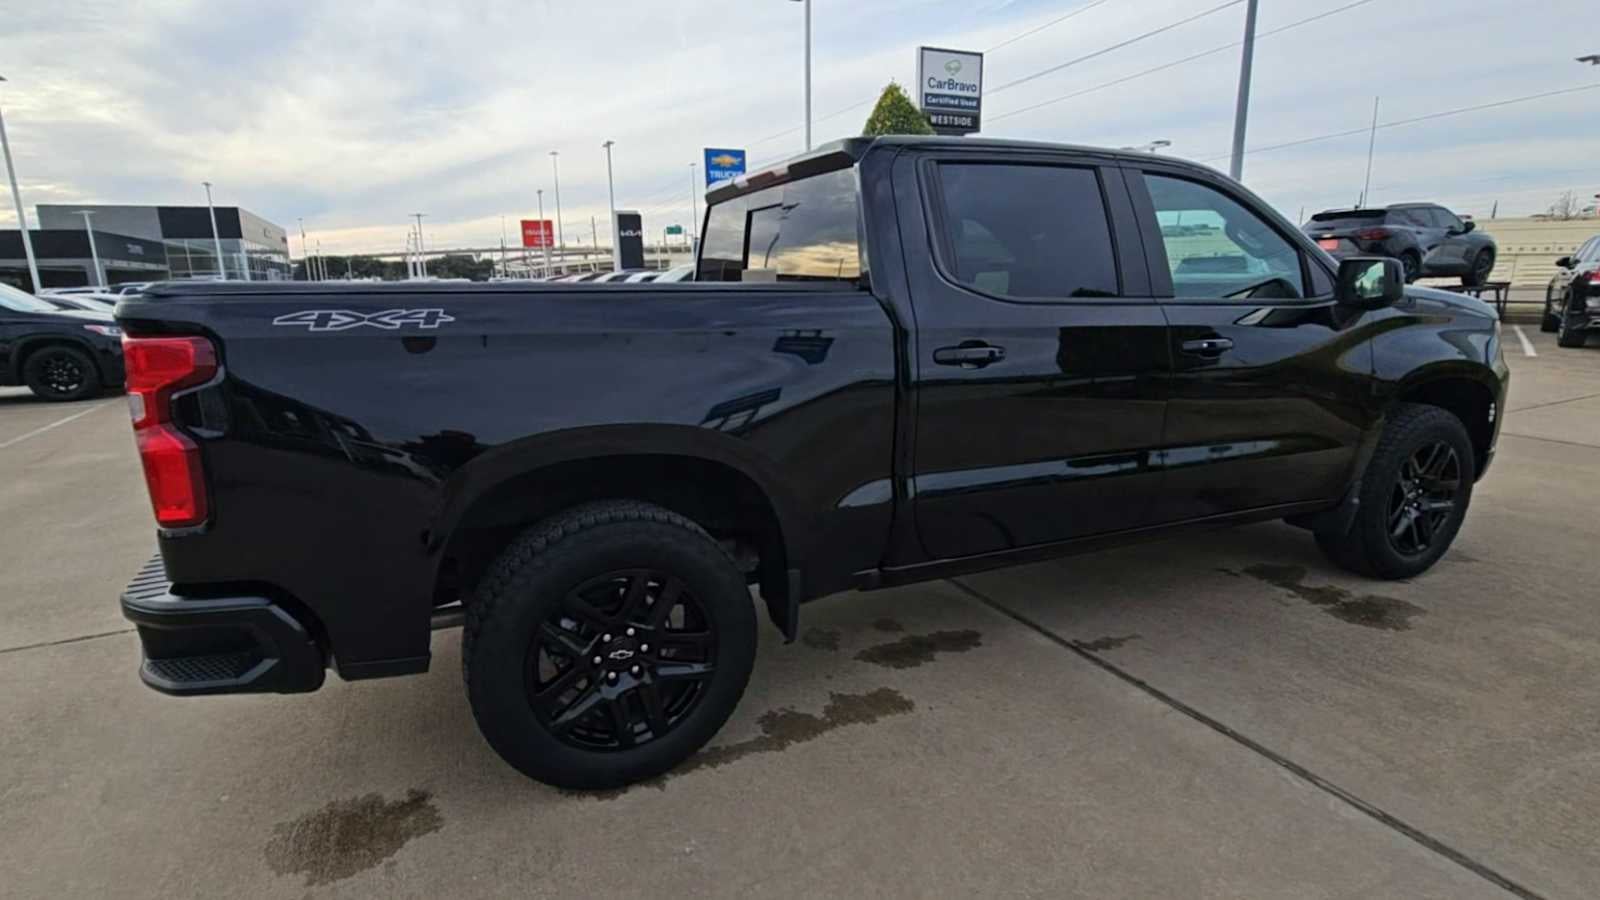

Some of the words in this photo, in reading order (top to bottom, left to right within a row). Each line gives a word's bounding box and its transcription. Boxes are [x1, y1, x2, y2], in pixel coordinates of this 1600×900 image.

[927, 77, 977, 92] CarBravo
[926, 95, 959, 105] Certified
[960, 99, 977, 107] Used
[930, 114, 972, 126] WESTSIDE
